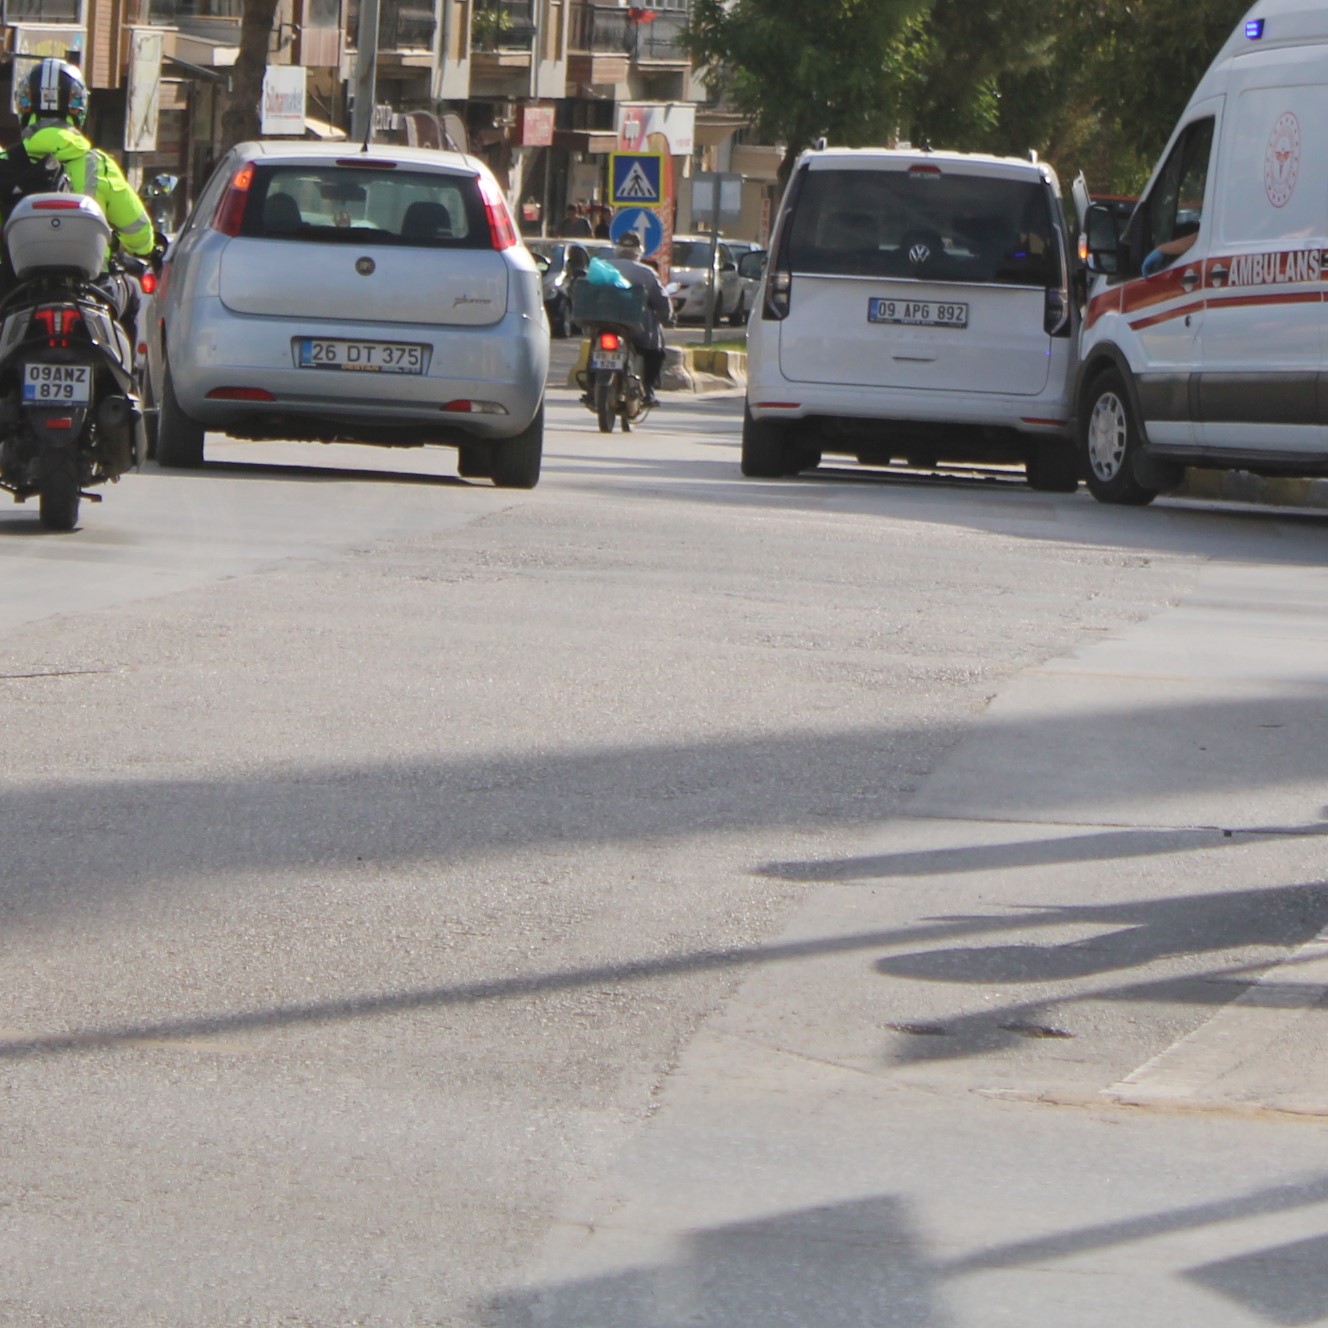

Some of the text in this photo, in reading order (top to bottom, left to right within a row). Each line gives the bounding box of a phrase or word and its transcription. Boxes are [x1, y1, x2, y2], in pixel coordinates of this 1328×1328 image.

[1228, 249, 1320, 286] AMBULANS
[878, 301, 896, 318] 09
[937, 305, 965, 322] 892
[312, 344, 419, 366] 26 DT 375
[40, 383, 74, 398] 879
